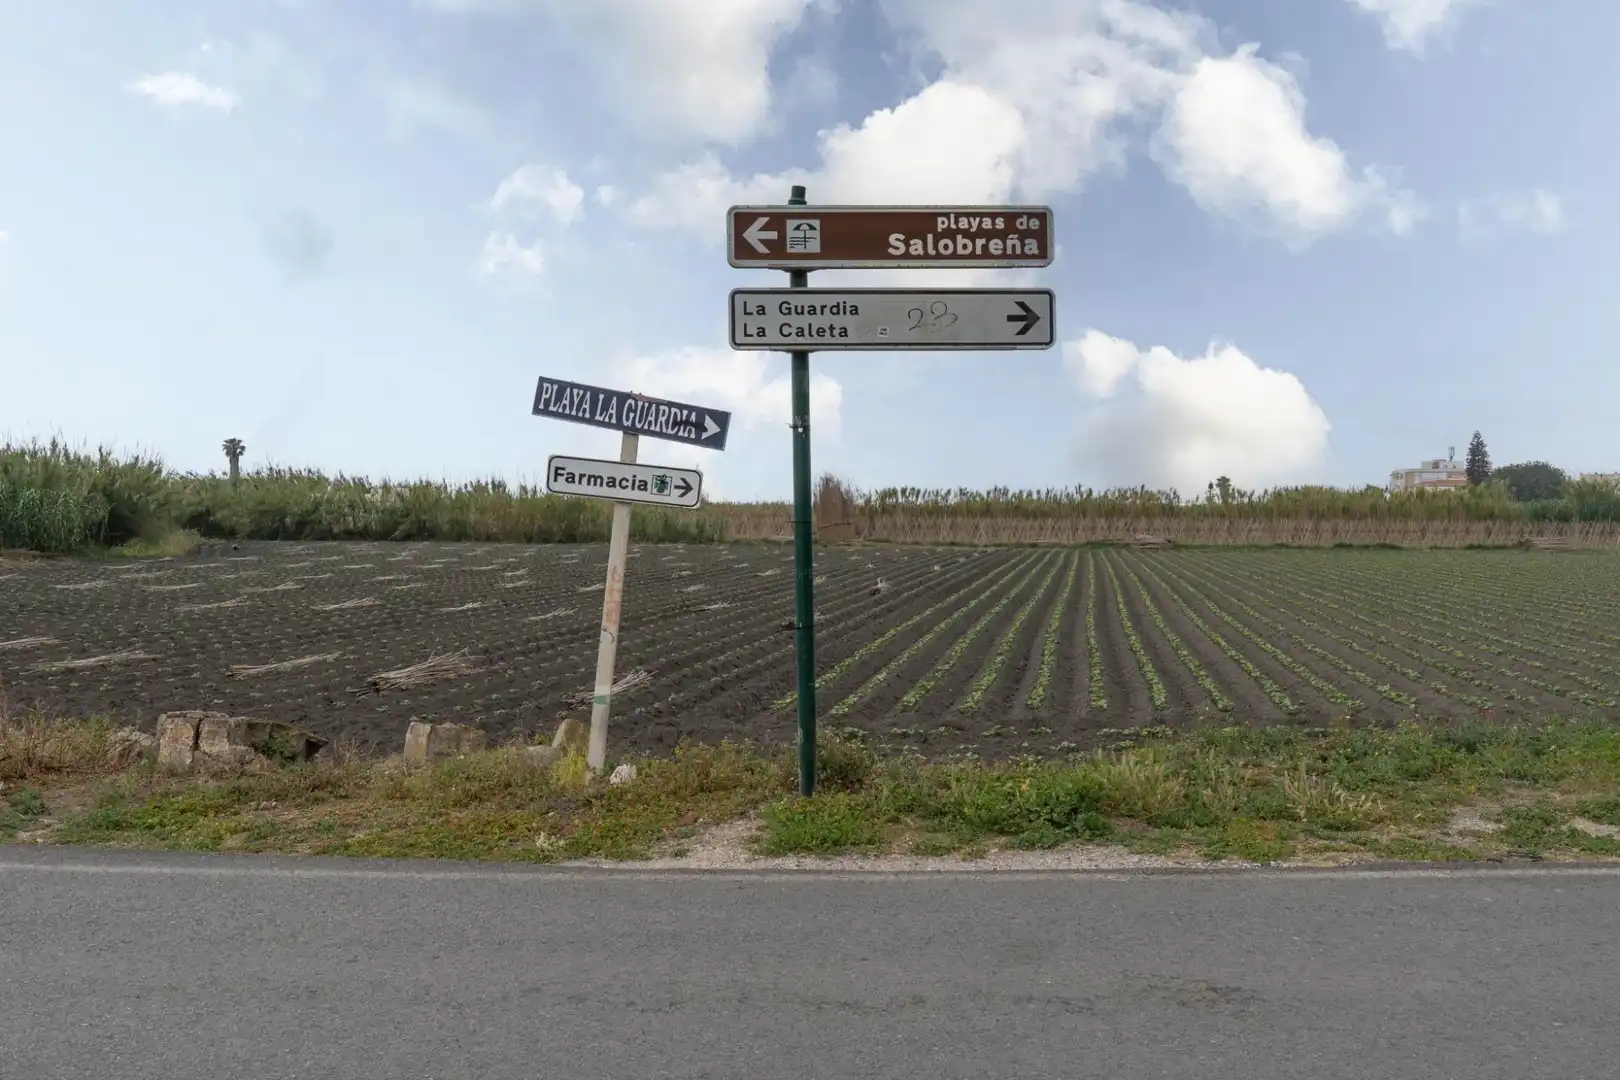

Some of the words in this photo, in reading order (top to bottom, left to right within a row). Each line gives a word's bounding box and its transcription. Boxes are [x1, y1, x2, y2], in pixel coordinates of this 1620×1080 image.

[937, 213, 1005, 232] playas
[1016, 215, 1040, 230] de
[888, 233, 1039, 255] Salobreña
[743, 301, 766, 316] La
[779, 301, 860, 316] Guardia
[743, 323, 766, 338] La
[779, 323, 849, 338] Caleta
[538, 382, 591, 418] PLAYA
[595, 393, 617, 424] LA
[622, 398, 697, 439] GUARDIA
[553, 466, 649, 492] Farmacia
